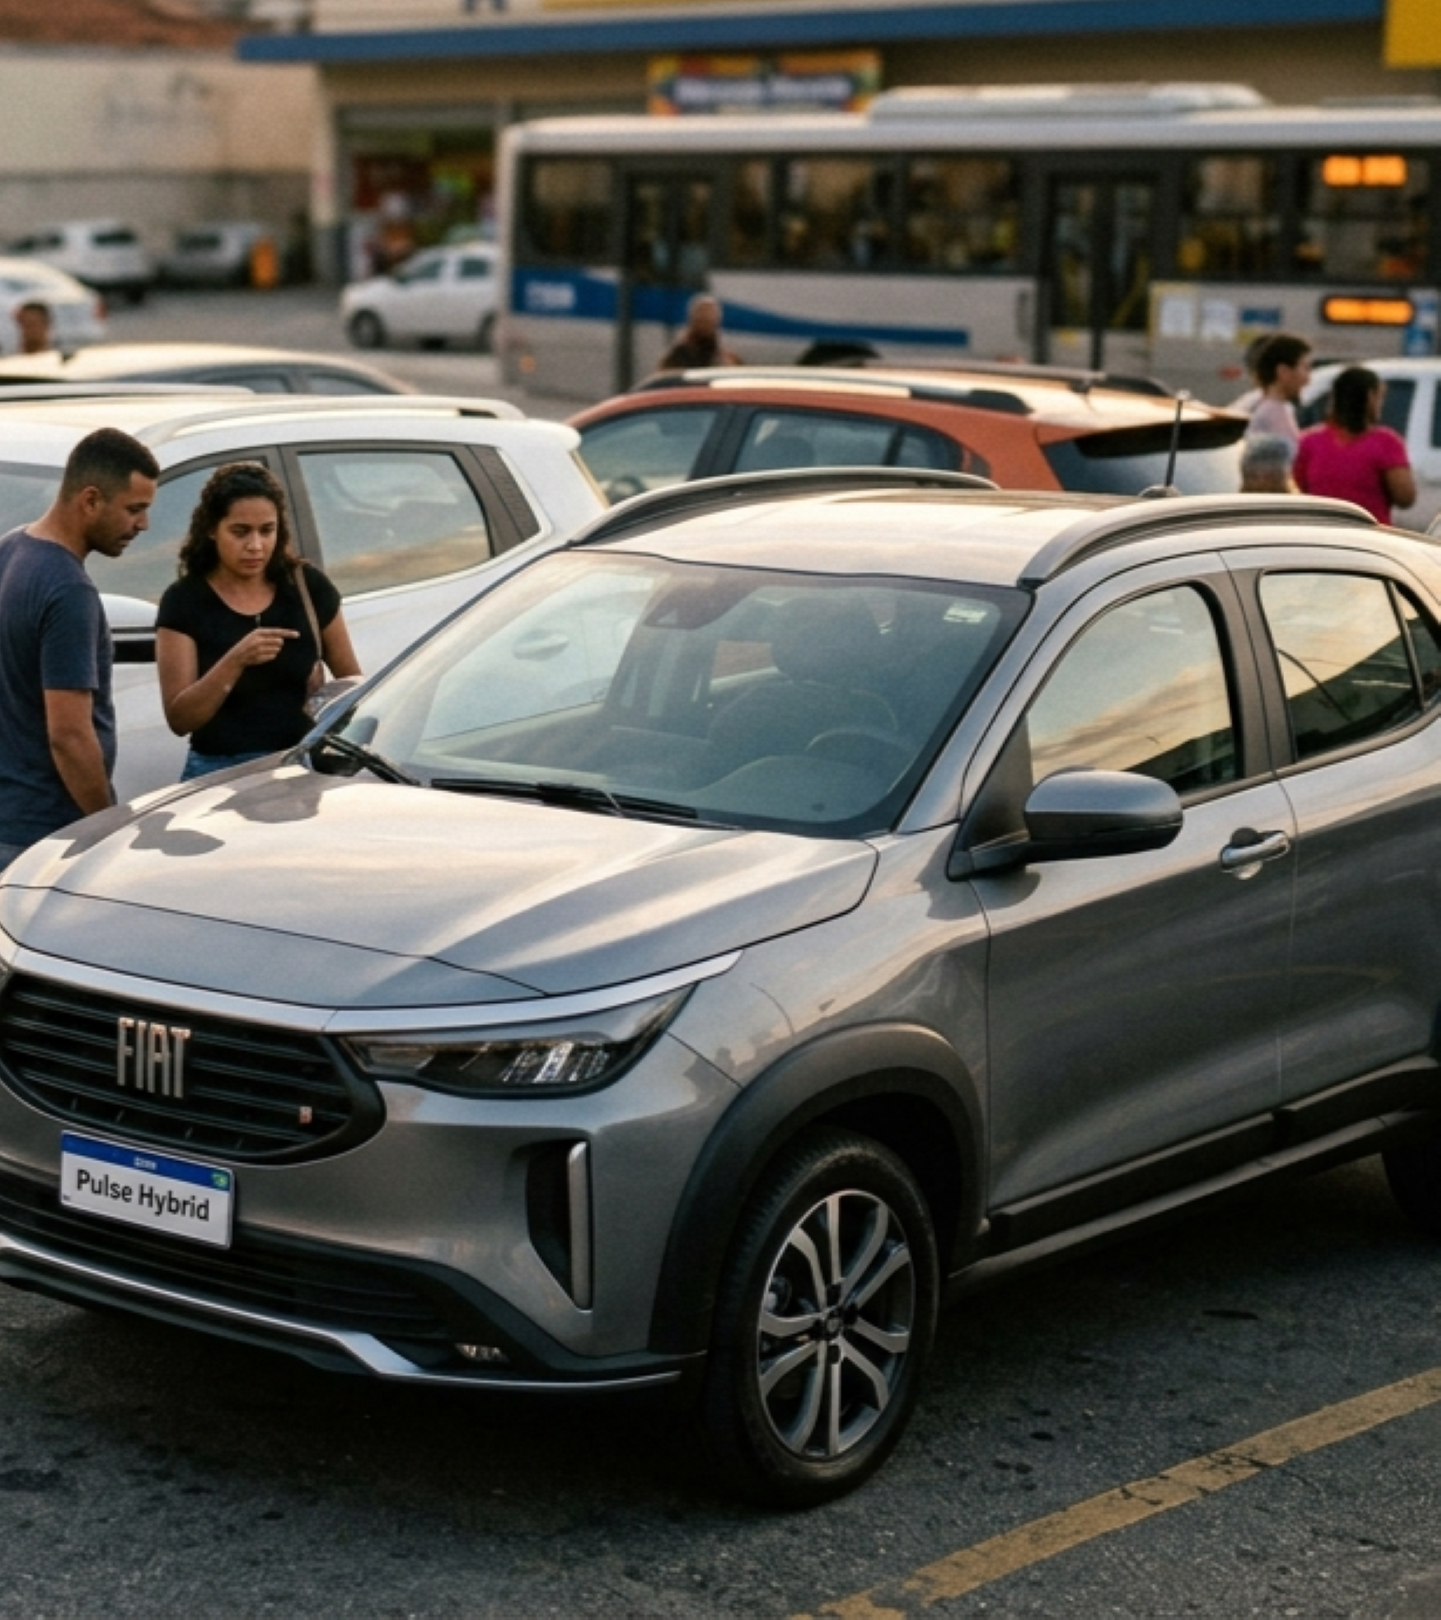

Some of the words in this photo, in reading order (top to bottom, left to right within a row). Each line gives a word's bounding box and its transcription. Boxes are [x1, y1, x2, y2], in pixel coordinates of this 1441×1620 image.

[117, 1017, 191, 1098] FIAT
[76, 1168, 133, 1203] Pulse
[138, 1183, 210, 1222] Hybrid
